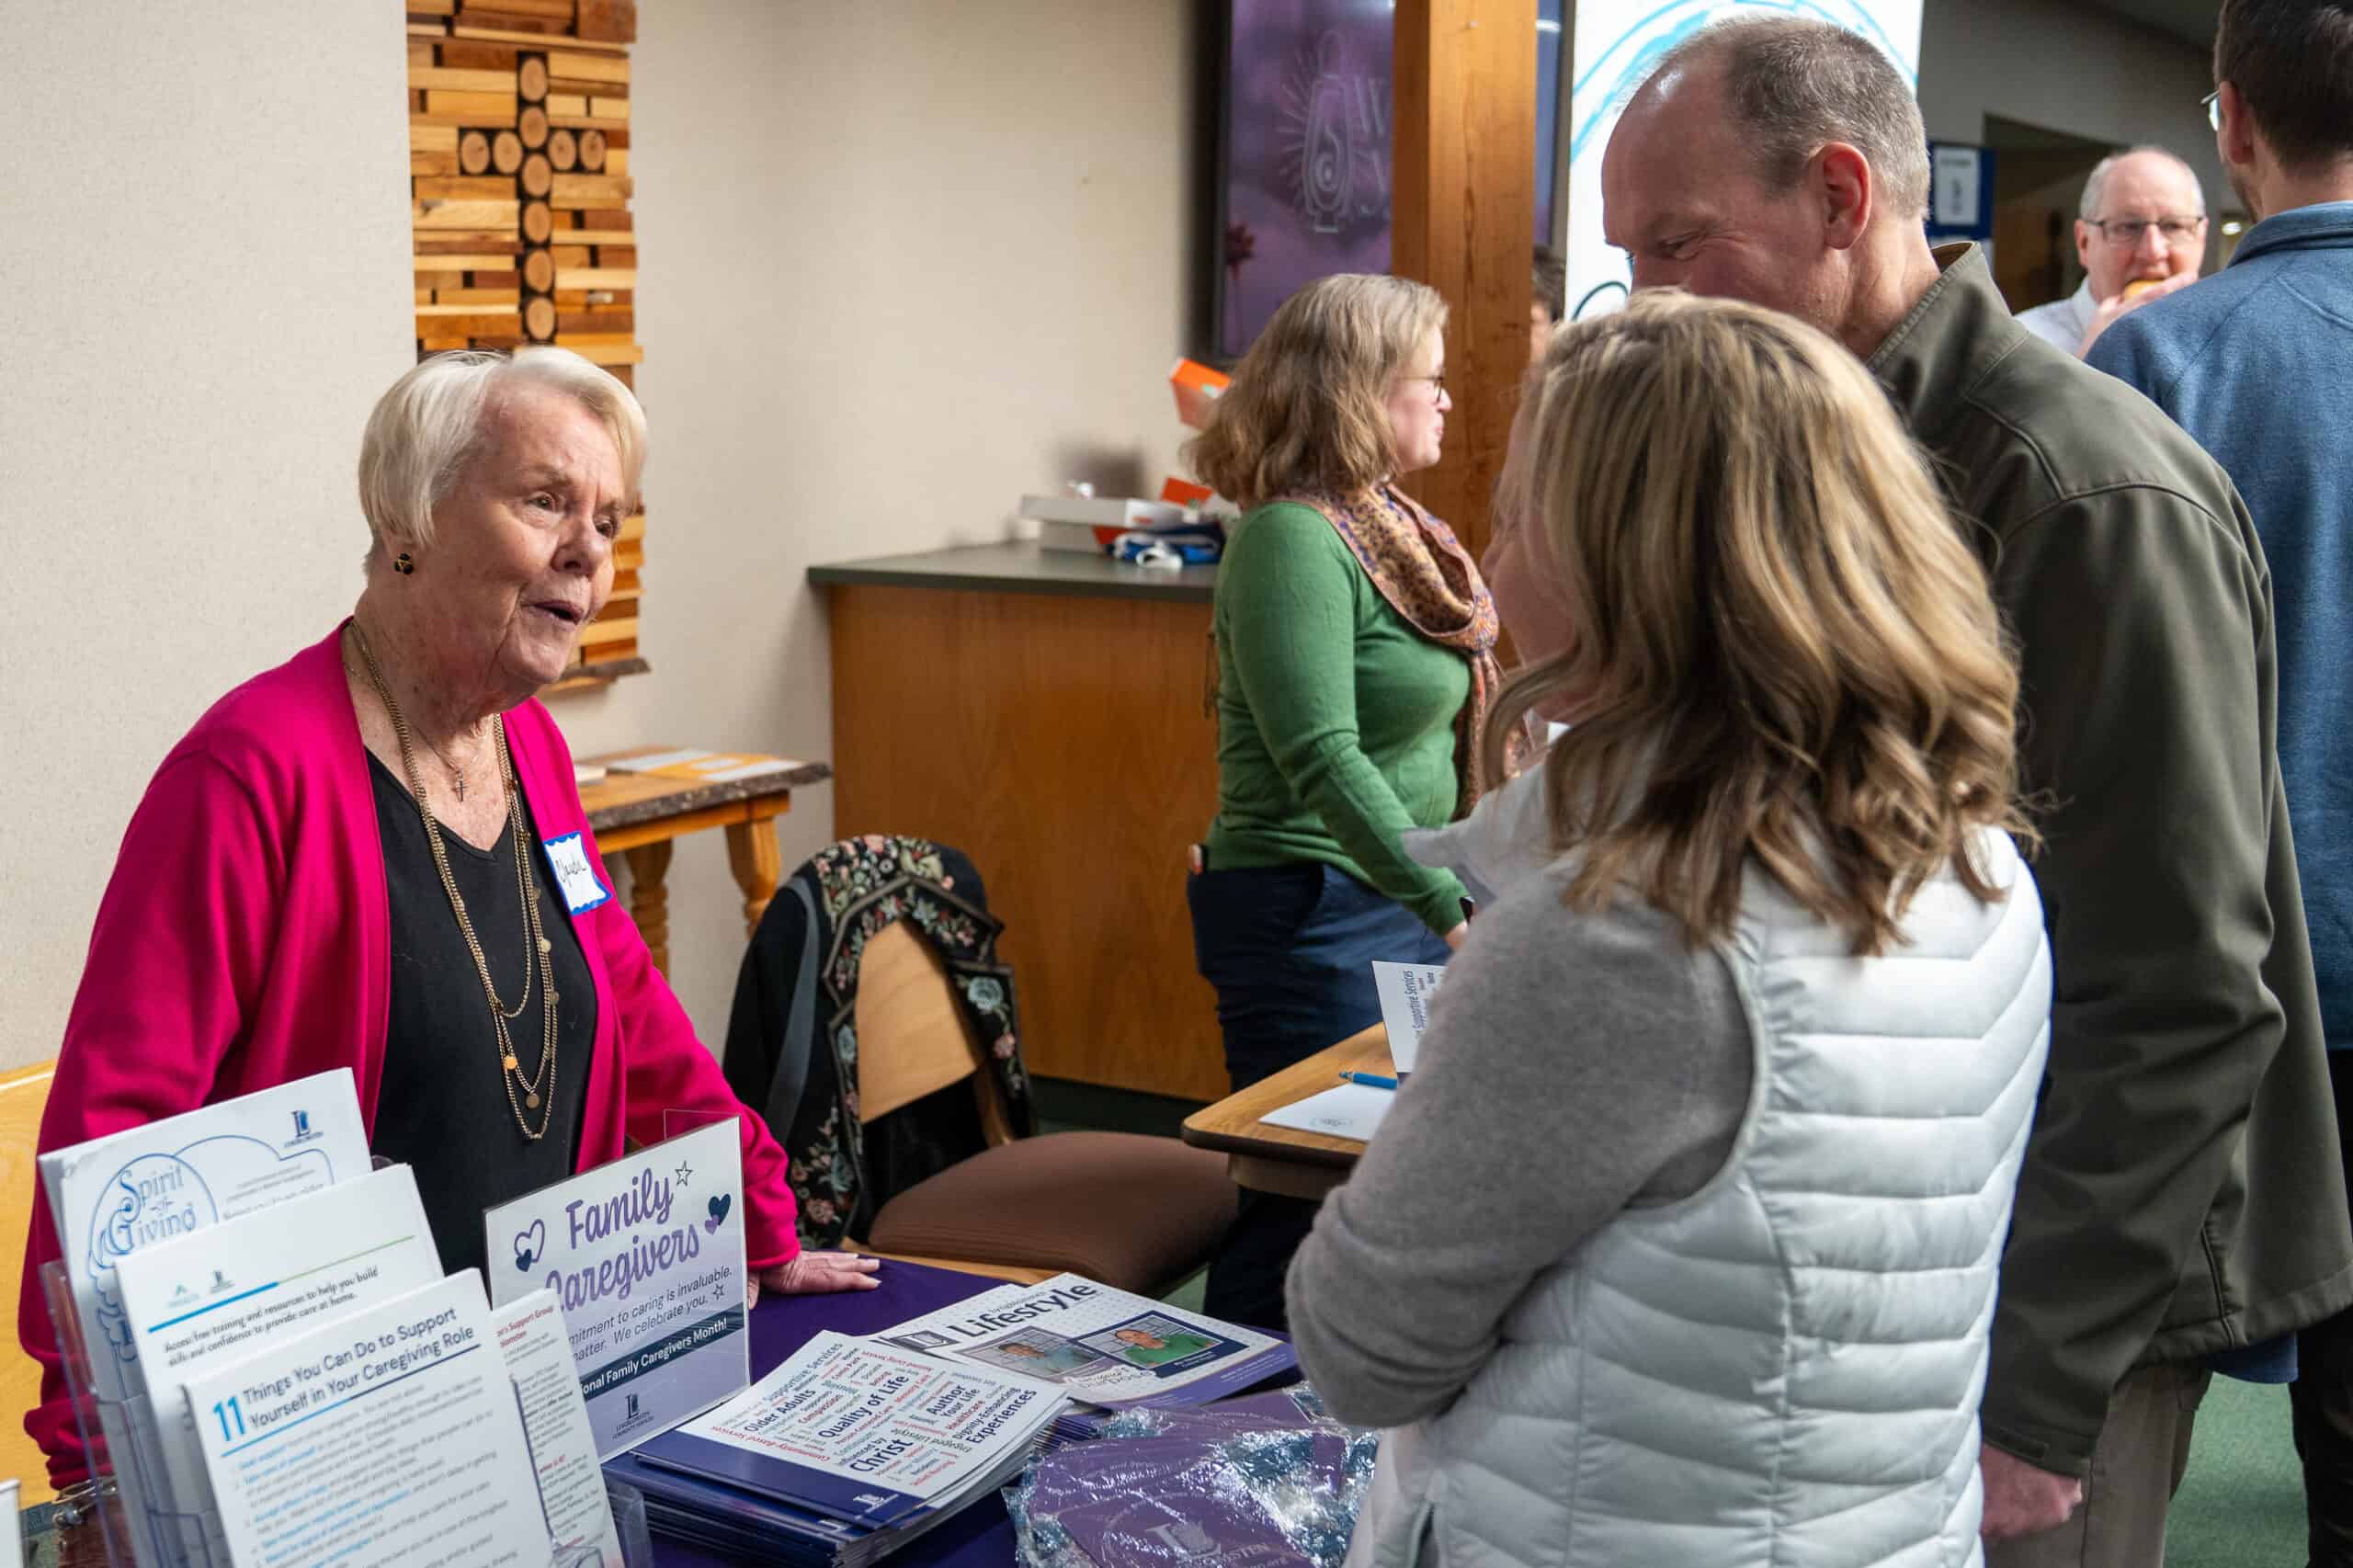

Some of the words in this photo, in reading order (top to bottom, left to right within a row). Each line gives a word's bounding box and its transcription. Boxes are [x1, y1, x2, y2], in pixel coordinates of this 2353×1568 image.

[1403, 970, 1417, 994] Services
[118, 1165, 185, 1211] Spirit
[565, 1167, 674, 1250] Family
[189, 1345, 207, 1360] and
[207, 1329, 254, 1357] confidence
[254, 1324, 265, 1335] to
[265, 1312, 298, 1335] provide
[299, 1305, 318, 1318] care
[319, 1300, 330, 1312] at
[329, 1291, 358, 1307] home.
[192, 1330, 210, 1344] free
[211, 1317, 246, 1336] training
[246, 1309, 263, 1323] and
[264, 1296, 306, 1316] resources
[306, 1290, 317, 1301] to
[317, 1282, 338, 1299] help
[338, 1278, 356, 1292] you
[356, 1265, 378, 1283] build
[508, 1310, 534, 1330] Support
[568, 1316, 616, 1344] mitment
[618, 1312, 631, 1326] to
[631, 1297, 665, 1324] caring
[666, 1289, 676, 1302] is
[676, 1265, 733, 1299] invaluable.
[613, 1326, 633, 1346] We
[633, 1302, 685, 1335] celebrate
[686, 1294, 709, 1316] you.
[947, 1285, 1097, 1338] Lifestyle
[242, 1377, 292, 1404] Things
[293, 1362, 322, 1383] You
[323, 1349, 354, 1371] Can
[354, 1340, 377, 1358] Do
[377, 1333, 395, 1347] to
[396, 1308, 457, 1341] Support
[249, 1393, 309, 1430] Yourself
[312, 1389, 326, 1403] in
[327, 1372, 361, 1394] Your
[362, 1340, 442, 1382] Caregiving
[442, 1325, 474, 1347] Role
[579, 1374, 605, 1396] ional
[606, 1359, 640, 1388] Family
[641, 1335, 692, 1369] Caregivers
[693, 1317, 728, 1343] Month!
[763, 1369, 811, 1403] Supportive
[807, 1343, 843, 1369] Services
[212, 1395, 246, 1442] 11
[744, 1414, 779, 1433] Older
[777, 1389, 816, 1415] Adults
[798, 1393, 844, 1425] Compassion
[818, 1406, 873, 1438] Quality
[868, 1393, 886, 1406] of
[879, 1375, 910, 1395] Life
[926, 1384, 966, 1415] Author
[940, 1403, 964, 1417] Your
[964, 1388, 981, 1403] Life
[945, 1399, 985, 1431] Healthcare
[952, 1387, 1022, 1439] Dignity-Enhancing
[966, 1389, 1037, 1444] Experiences
[850, 1438, 914, 1471] Christ
